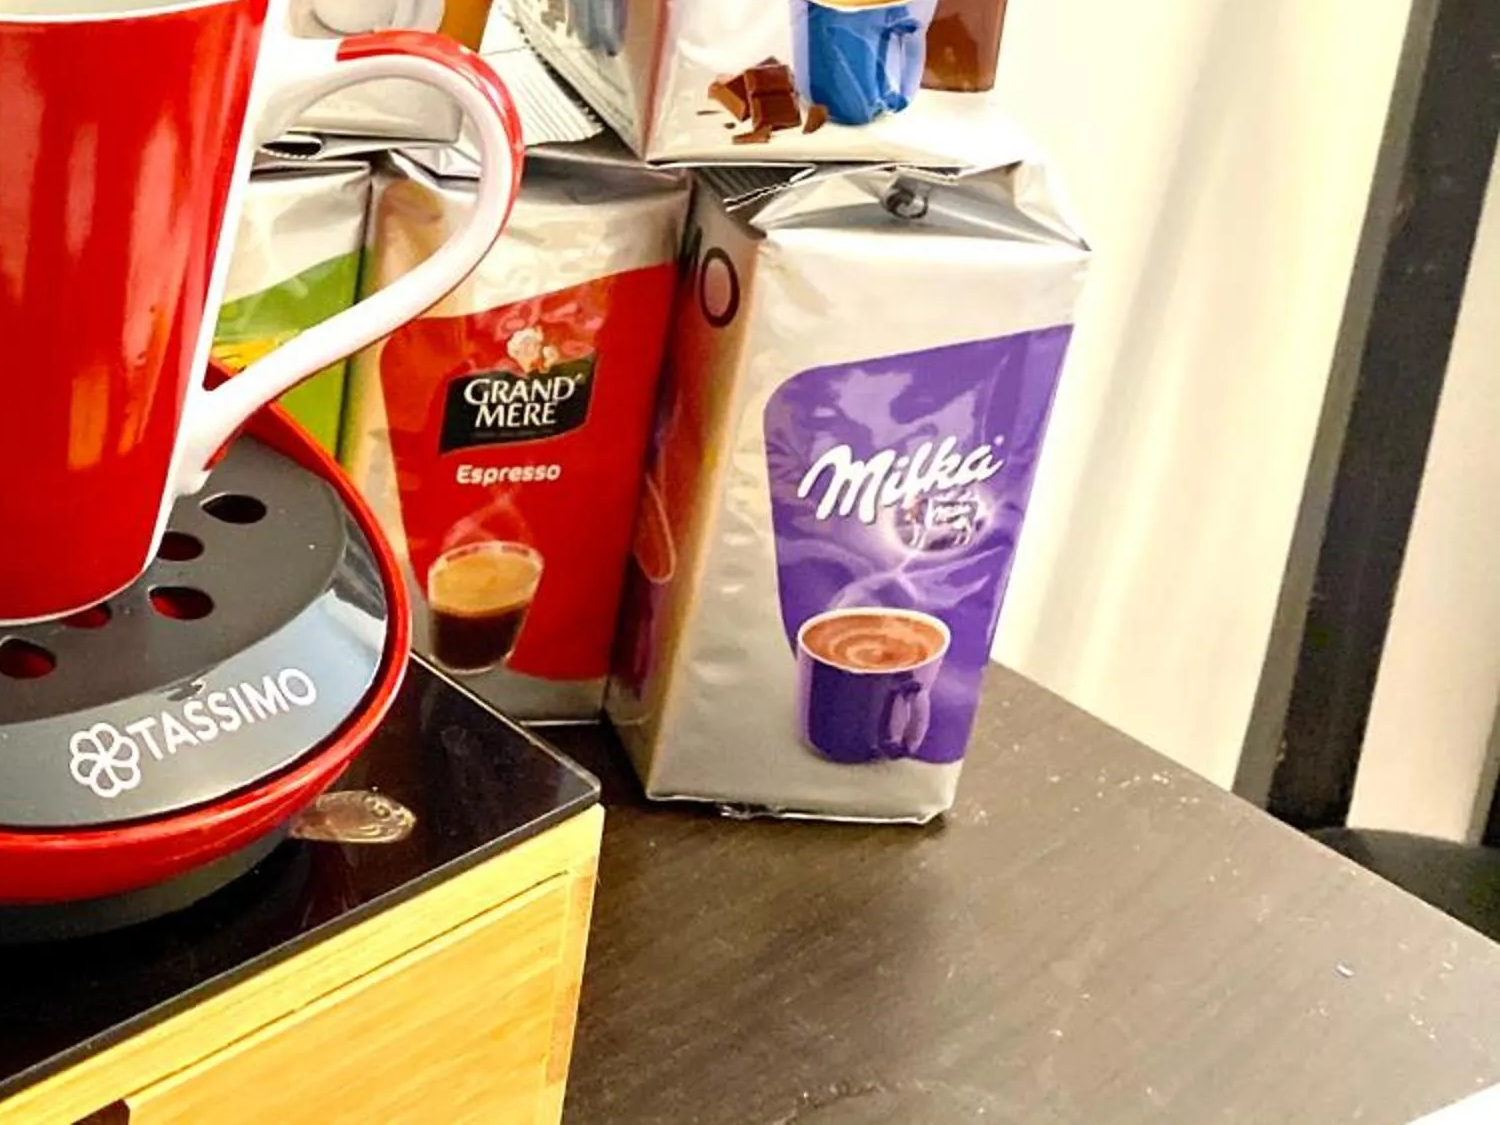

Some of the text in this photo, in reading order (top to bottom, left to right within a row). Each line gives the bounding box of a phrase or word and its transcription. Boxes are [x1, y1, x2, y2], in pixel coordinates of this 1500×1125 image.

[463, 373, 583, 406] GRAND'
[456, 463, 562, 487] Espresso
[797, 435, 1004, 525] Milka
[124, 667, 318, 761] TASSIMO
